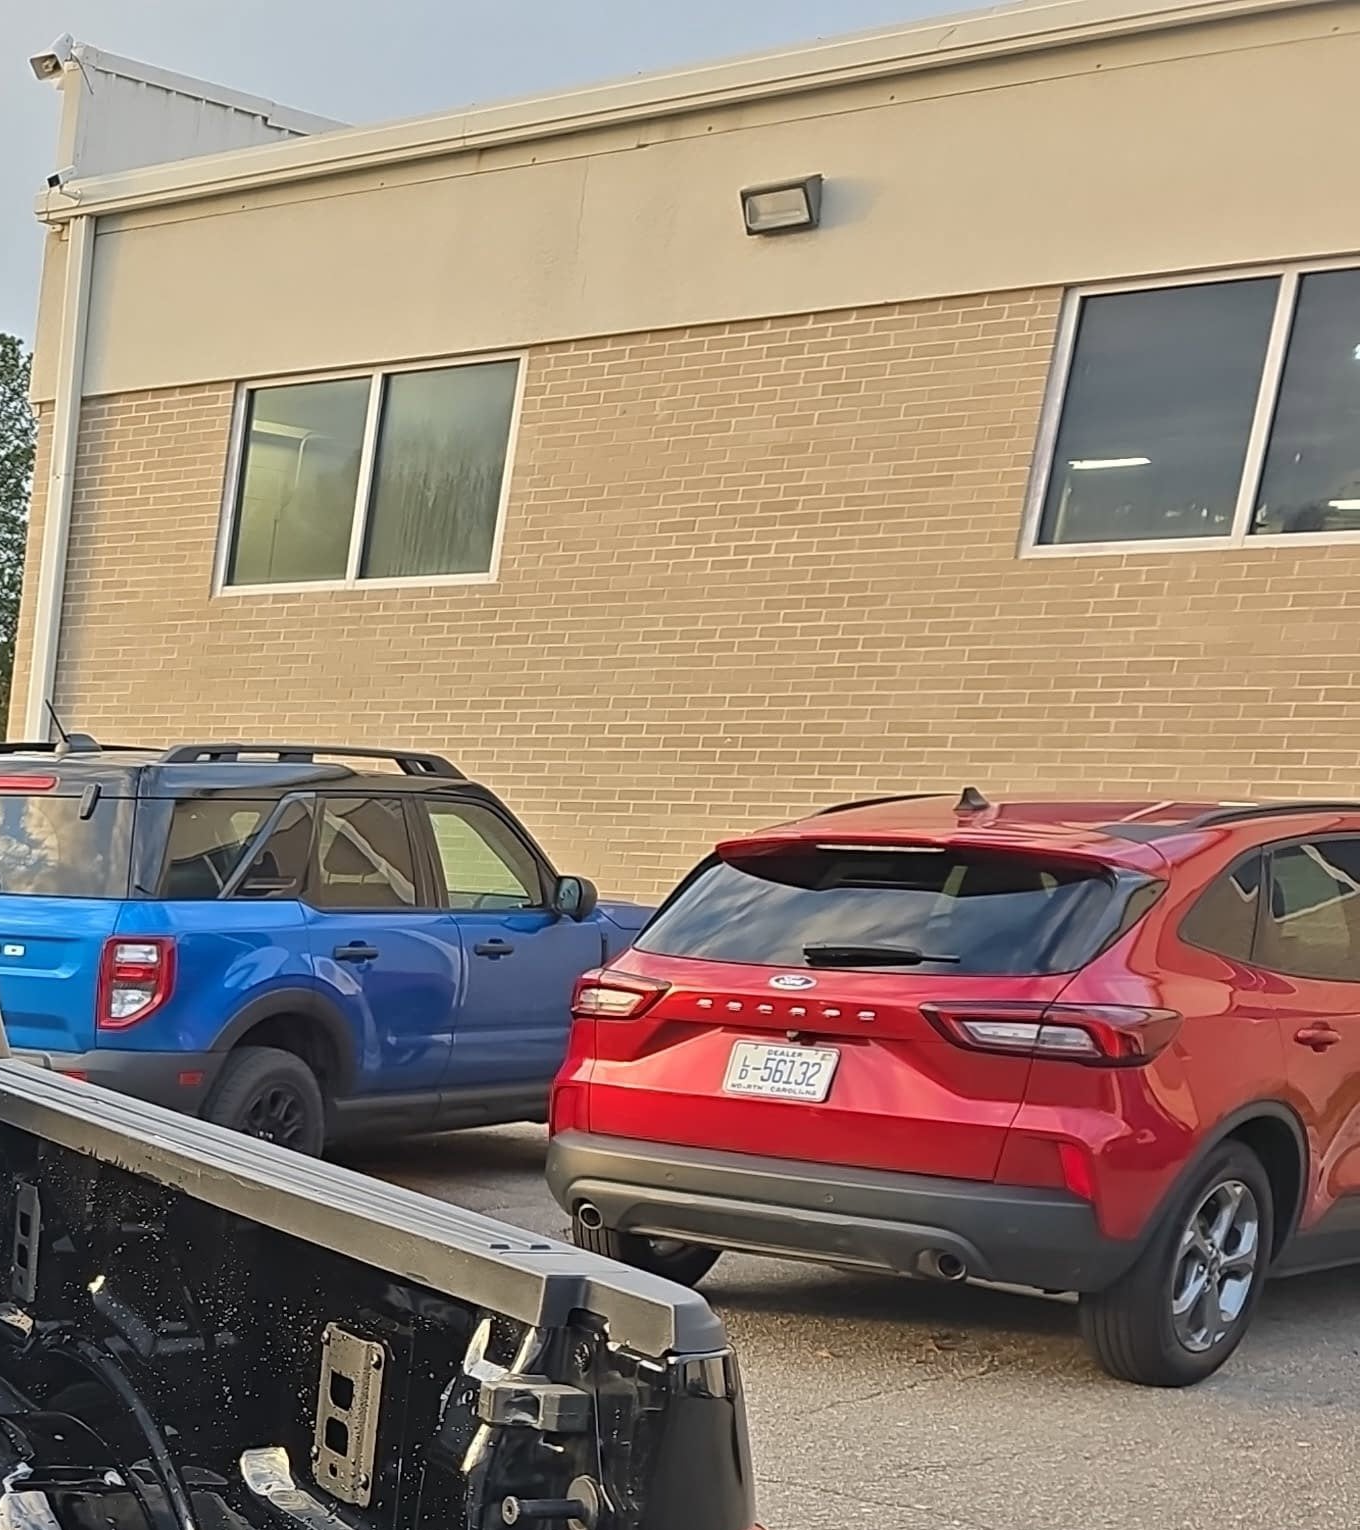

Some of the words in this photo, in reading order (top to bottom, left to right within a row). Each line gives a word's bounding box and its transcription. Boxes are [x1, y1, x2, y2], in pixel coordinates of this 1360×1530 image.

[767, 1049, 803, 1058] DEALER
[731, 1082, 764, 1091] NORTH
[770, 1086, 817, 1096] CAROLINA
